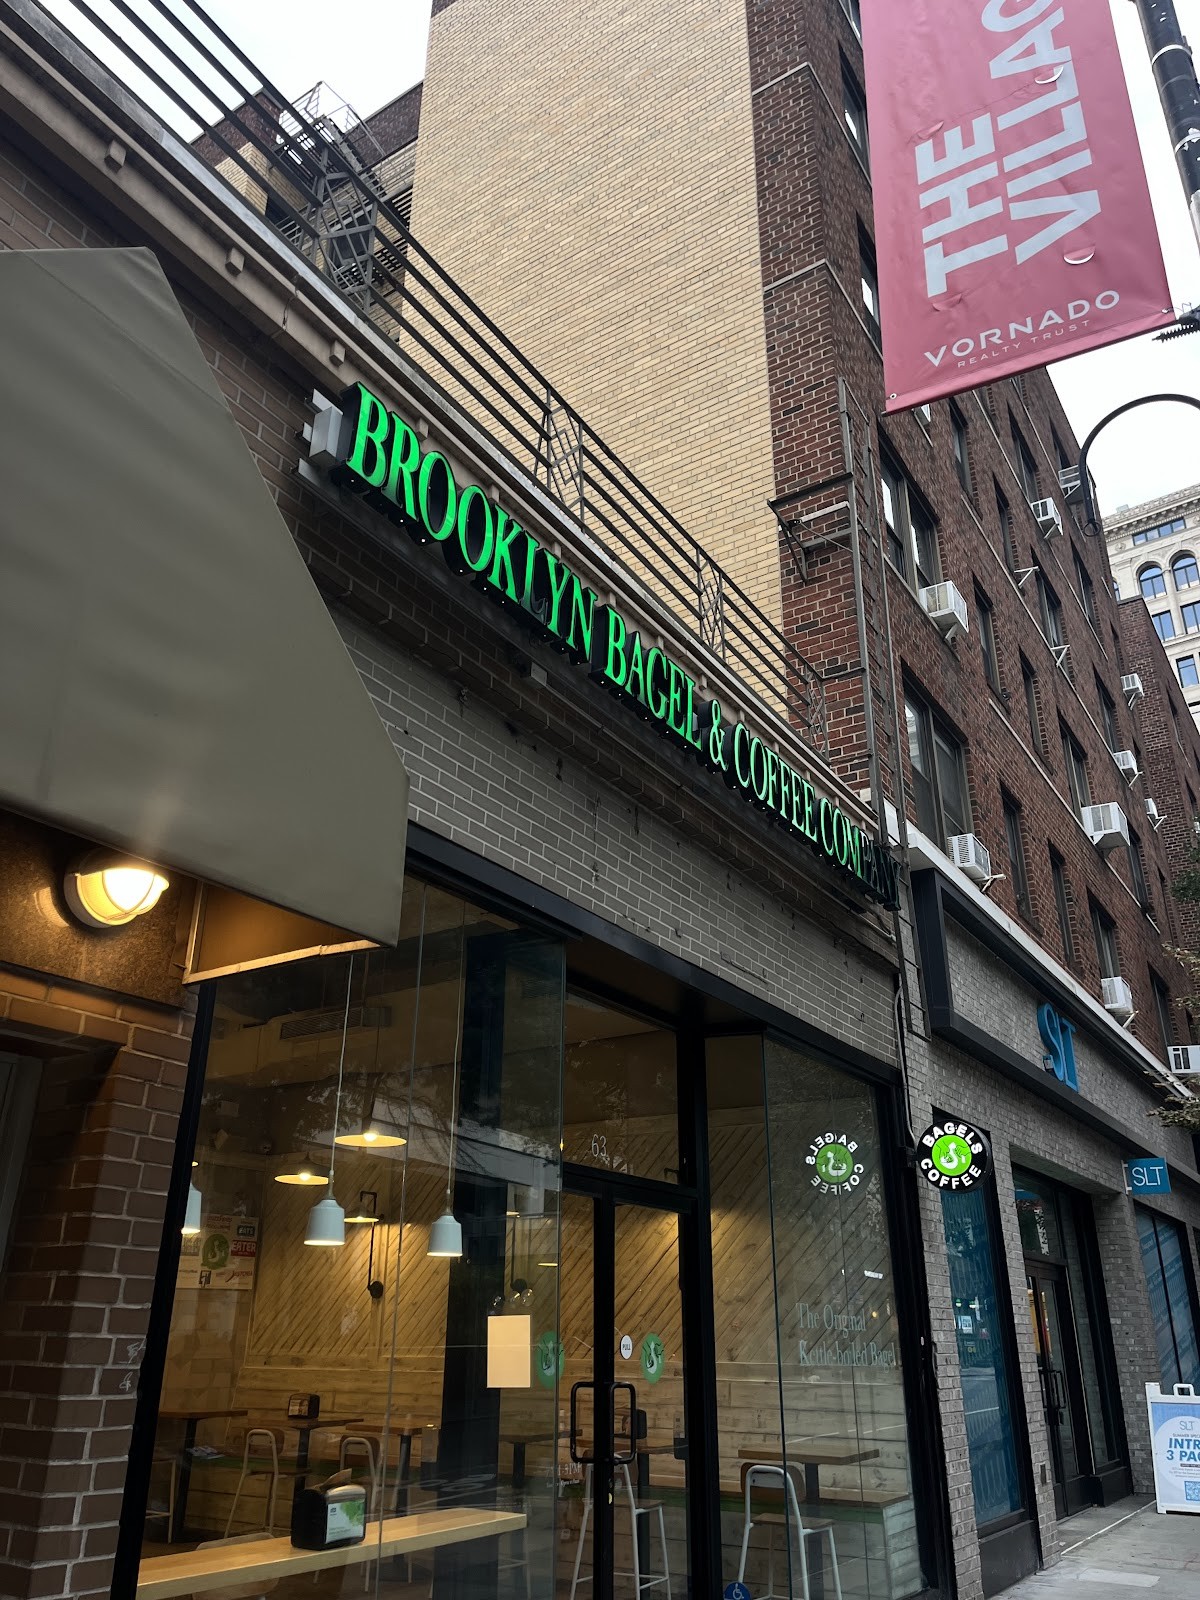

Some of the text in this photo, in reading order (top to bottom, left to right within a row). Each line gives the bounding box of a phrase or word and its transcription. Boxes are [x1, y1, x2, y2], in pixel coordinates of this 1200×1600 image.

[915, 112, 1008, 298] THE
[924, 290, 1120, 367] VORNADO
[957, 320, 1090, 368] REALTY TRUST
[346, 381, 598, 661] BROOKLYN
[604, 606, 703, 751] BAGEL
[709, 699, 729, 772] &
[734, 722, 818, 843] COFFEE
[592, 1133, 606, 1157] 63
[922, 1122, 983, 1155] BAGELS
[920, 1158, 982, 1190] COFFEE
[1131, 1166, 1164, 1186] SLT
[232, 1242, 256, 1252] EATER
[796, 1302, 866, 1338] The Original
[622, 1343, 631, 1351] PULL
[1180, 1420, 1195, 1431] SLT
[1166, 1449, 1174, 1461] 3
